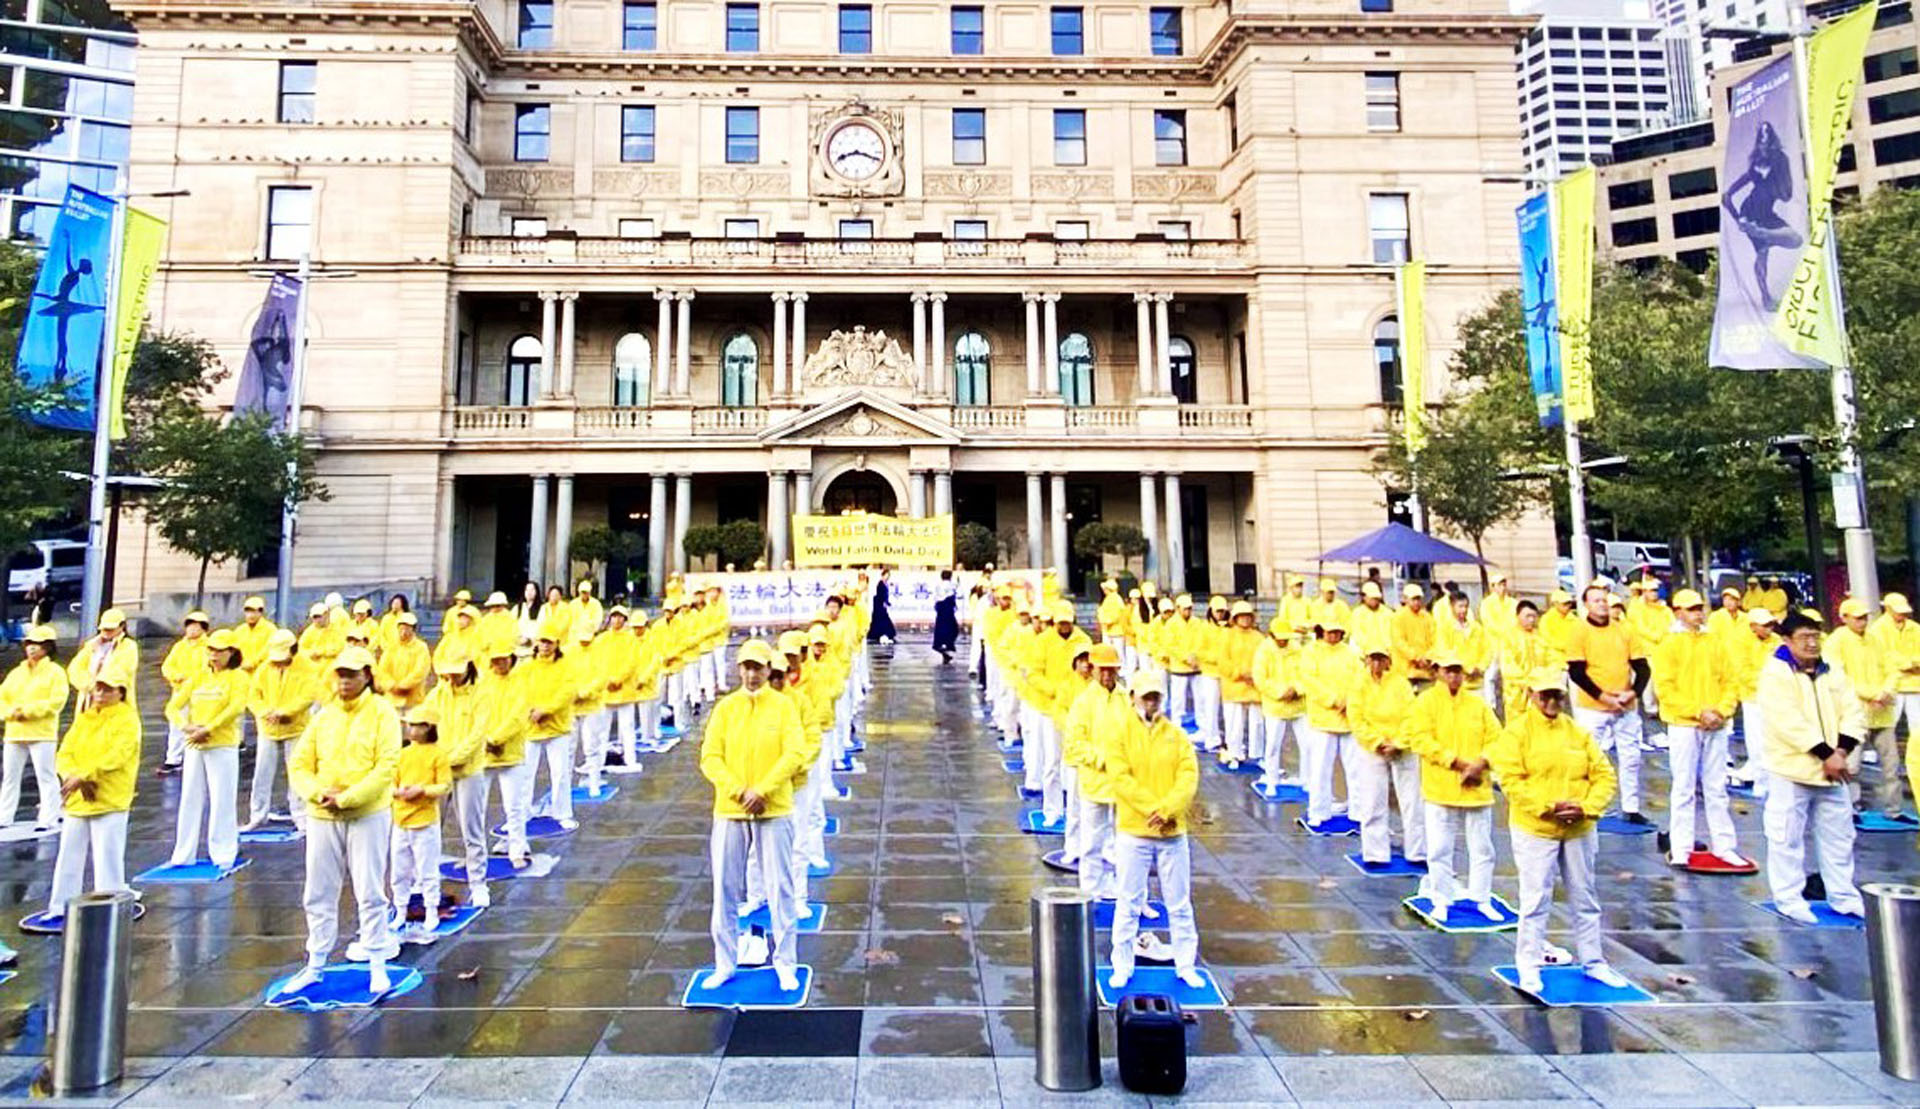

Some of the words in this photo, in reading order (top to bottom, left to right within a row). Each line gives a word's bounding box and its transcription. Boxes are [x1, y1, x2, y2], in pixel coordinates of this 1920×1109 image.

[805, 546, 842, 556] World
[729, 576, 848, 600] 法輪大法
